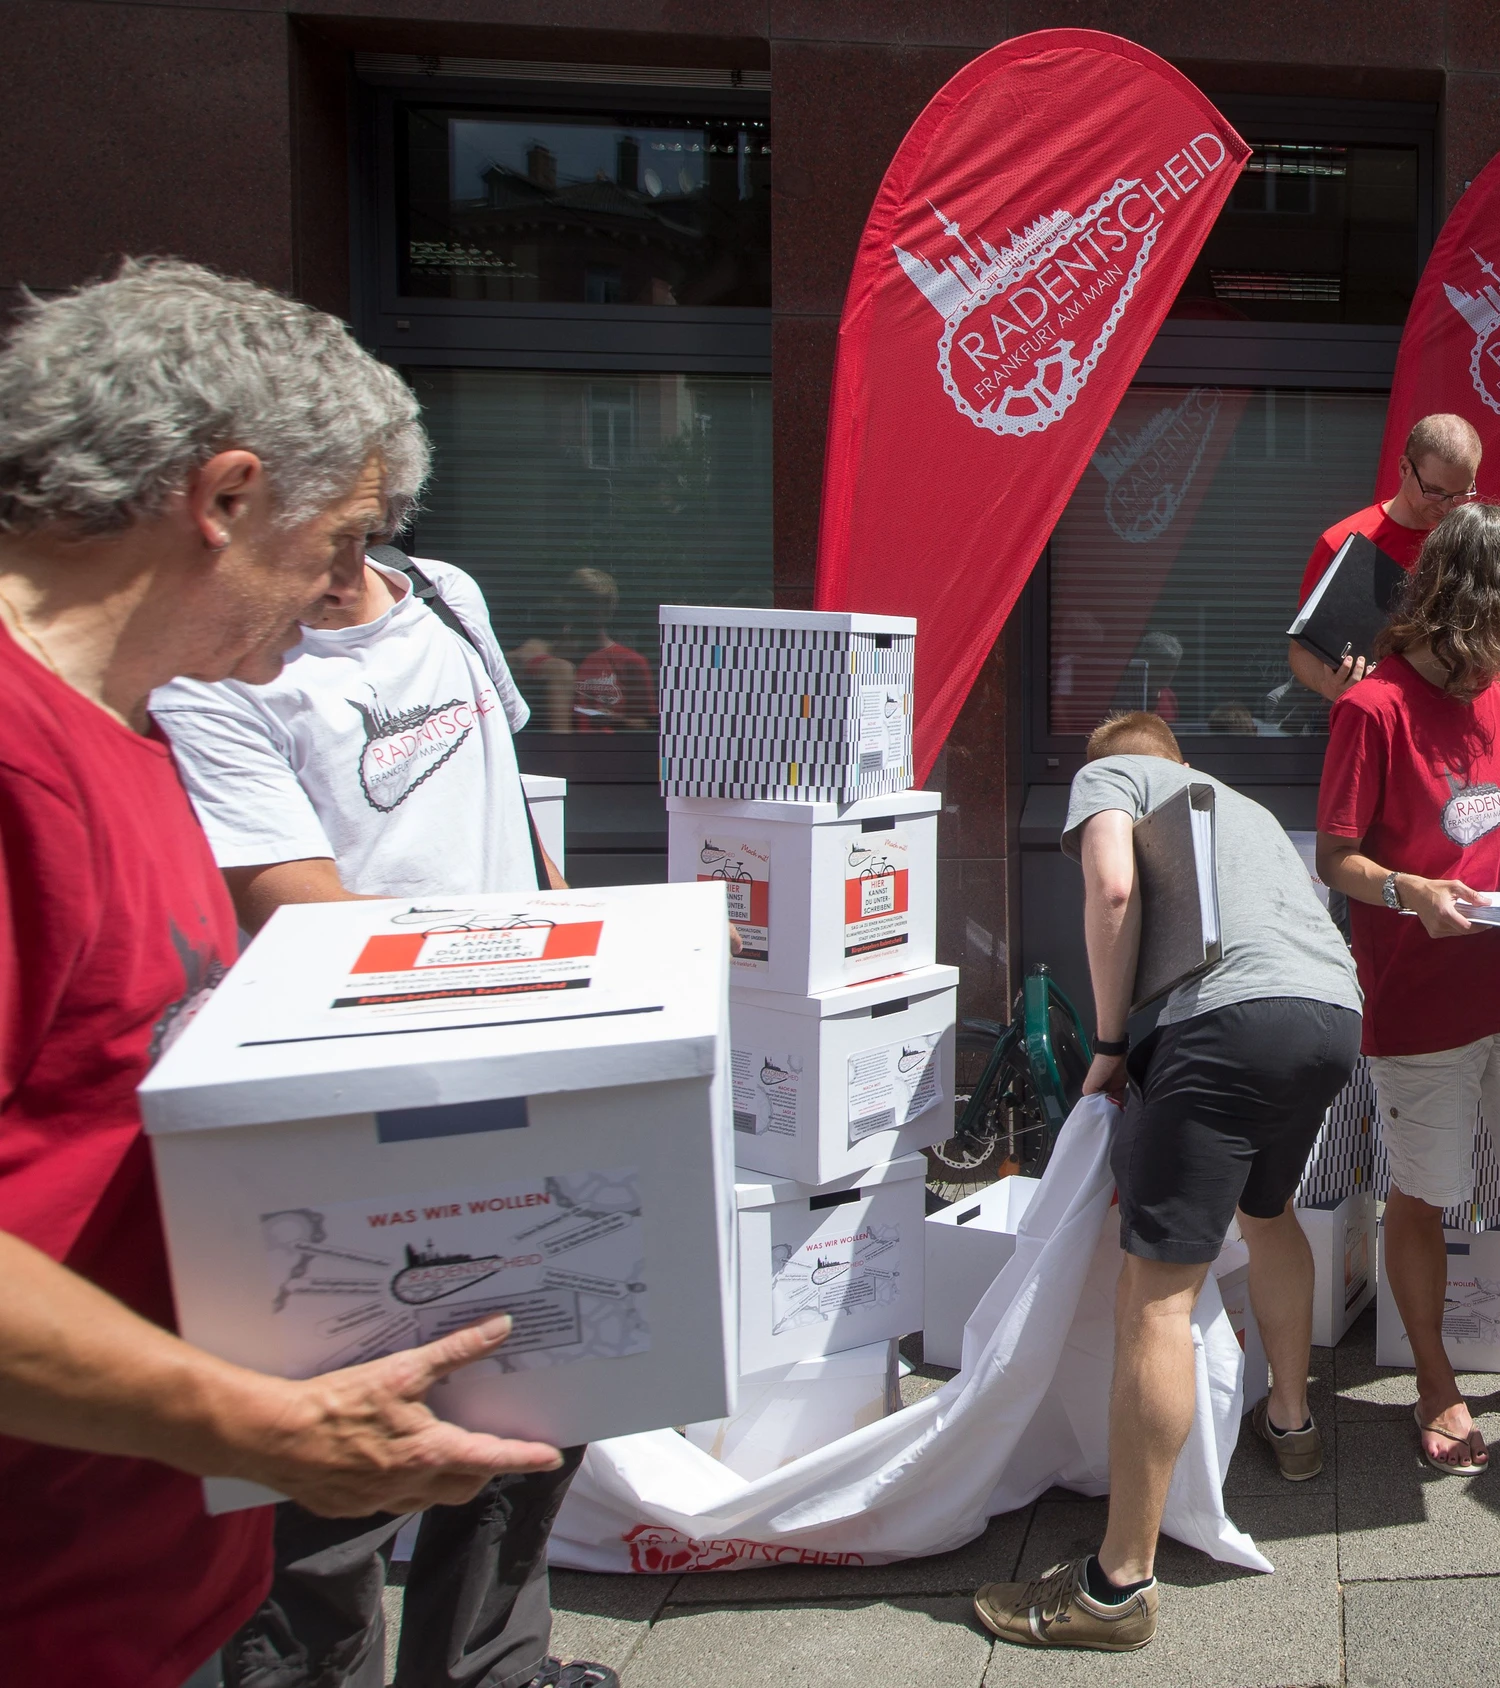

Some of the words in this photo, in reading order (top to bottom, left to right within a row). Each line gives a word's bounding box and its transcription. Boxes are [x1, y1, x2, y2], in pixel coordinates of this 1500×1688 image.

[957, 132, 1226, 372] RADENTSCHEID
[973, 322, 1057, 400] FRANKFURT
[1058, 300, 1085, 329] AM
[1081, 263, 1124, 309] MAIN
[868, 887, 888, 896] KANNST
[870, 880, 885, 888] HIER
[450, 938, 522, 948] KANNST
[463, 931, 513, 941] HIER
[366, 1209, 419, 1228] WAS
[423, 1203, 463, 1221] WIR
[467, 1192, 551, 1215] WOLLEN
[806, 1242, 823, 1252] WAS
[825, 1239, 838, 1248] WIR
[840, 1233, 869, 1244] WOLLEN
[408, 1253, 544, 1283] RADENTSCHEID
